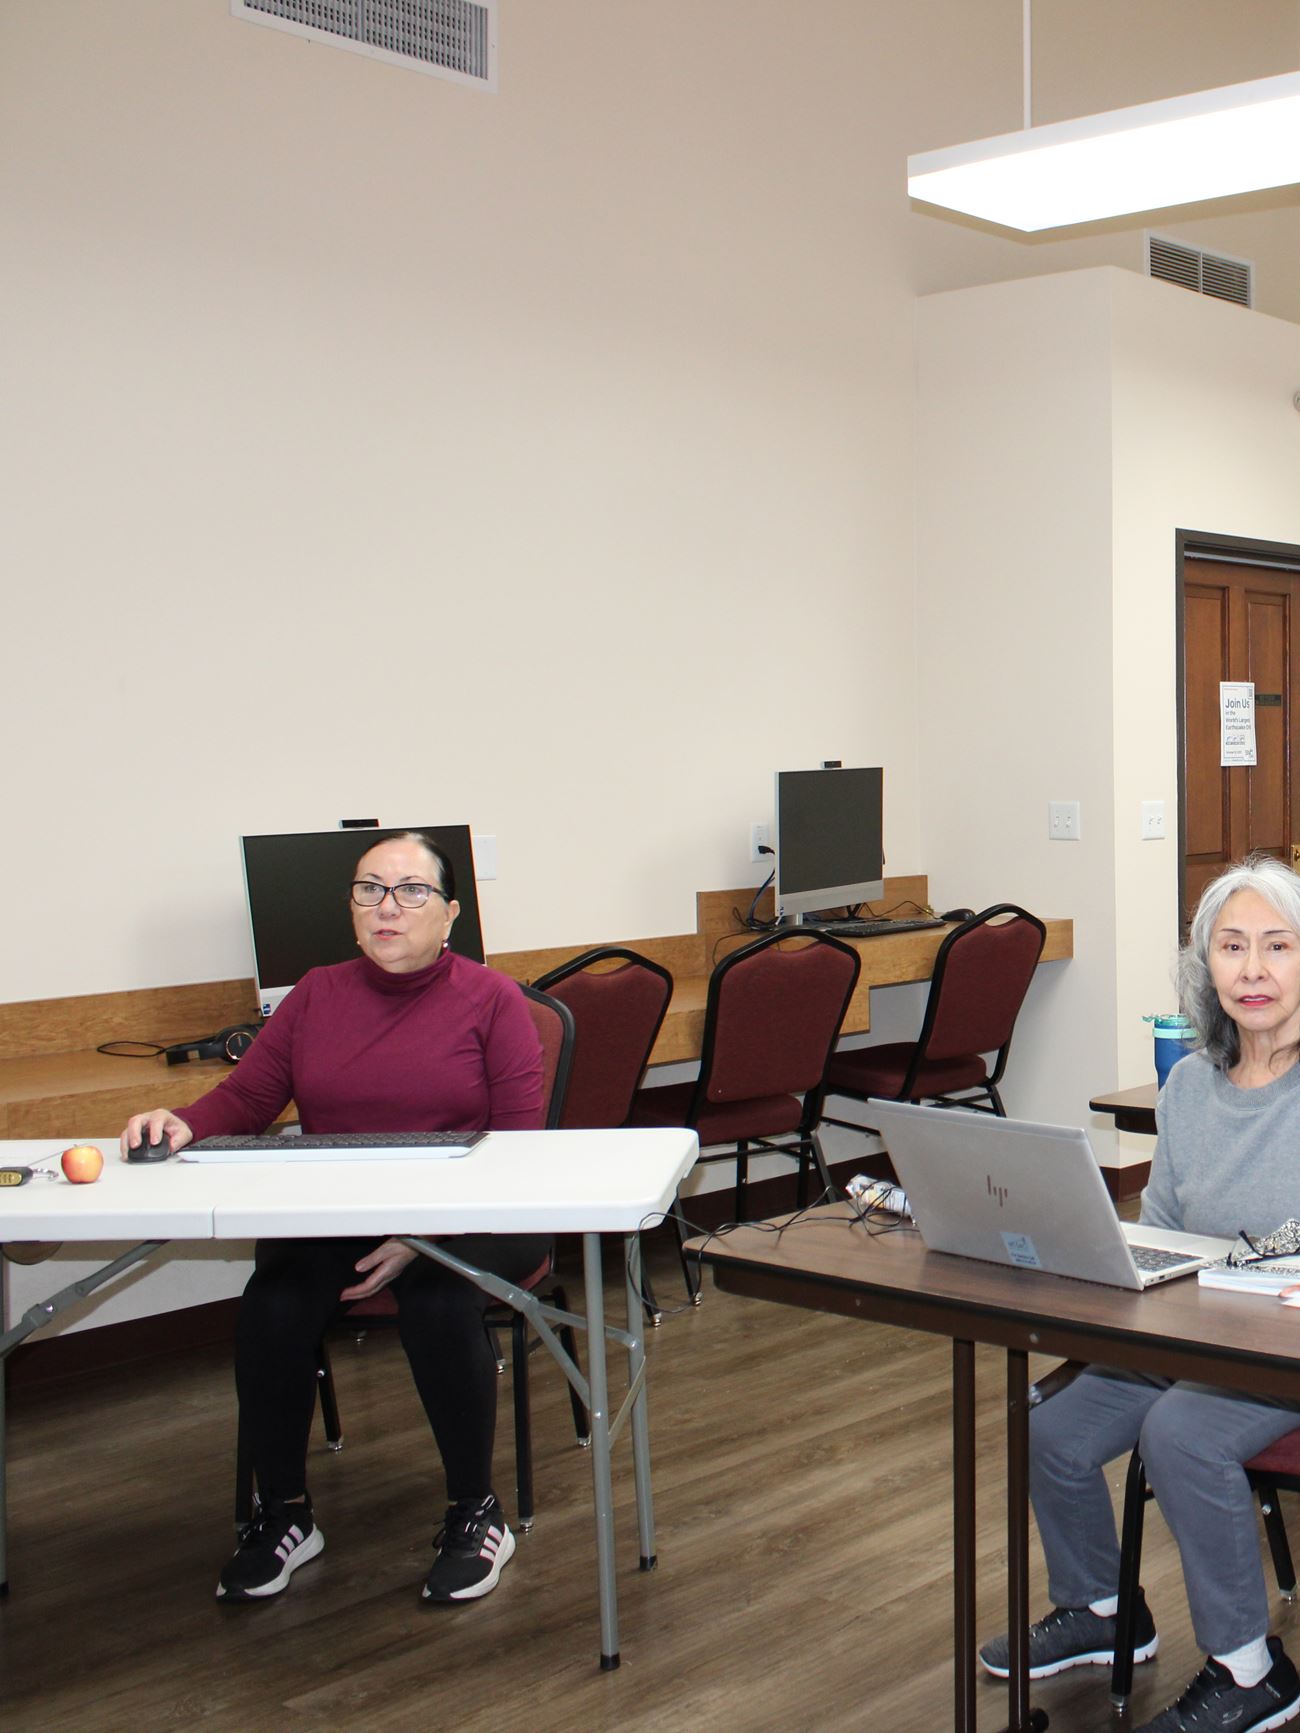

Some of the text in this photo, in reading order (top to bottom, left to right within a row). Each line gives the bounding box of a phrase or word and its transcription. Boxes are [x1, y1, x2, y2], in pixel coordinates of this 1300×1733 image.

[1225, 698, 1250, 709] Join Us
[986, 1174, 1009, 1209] hp
